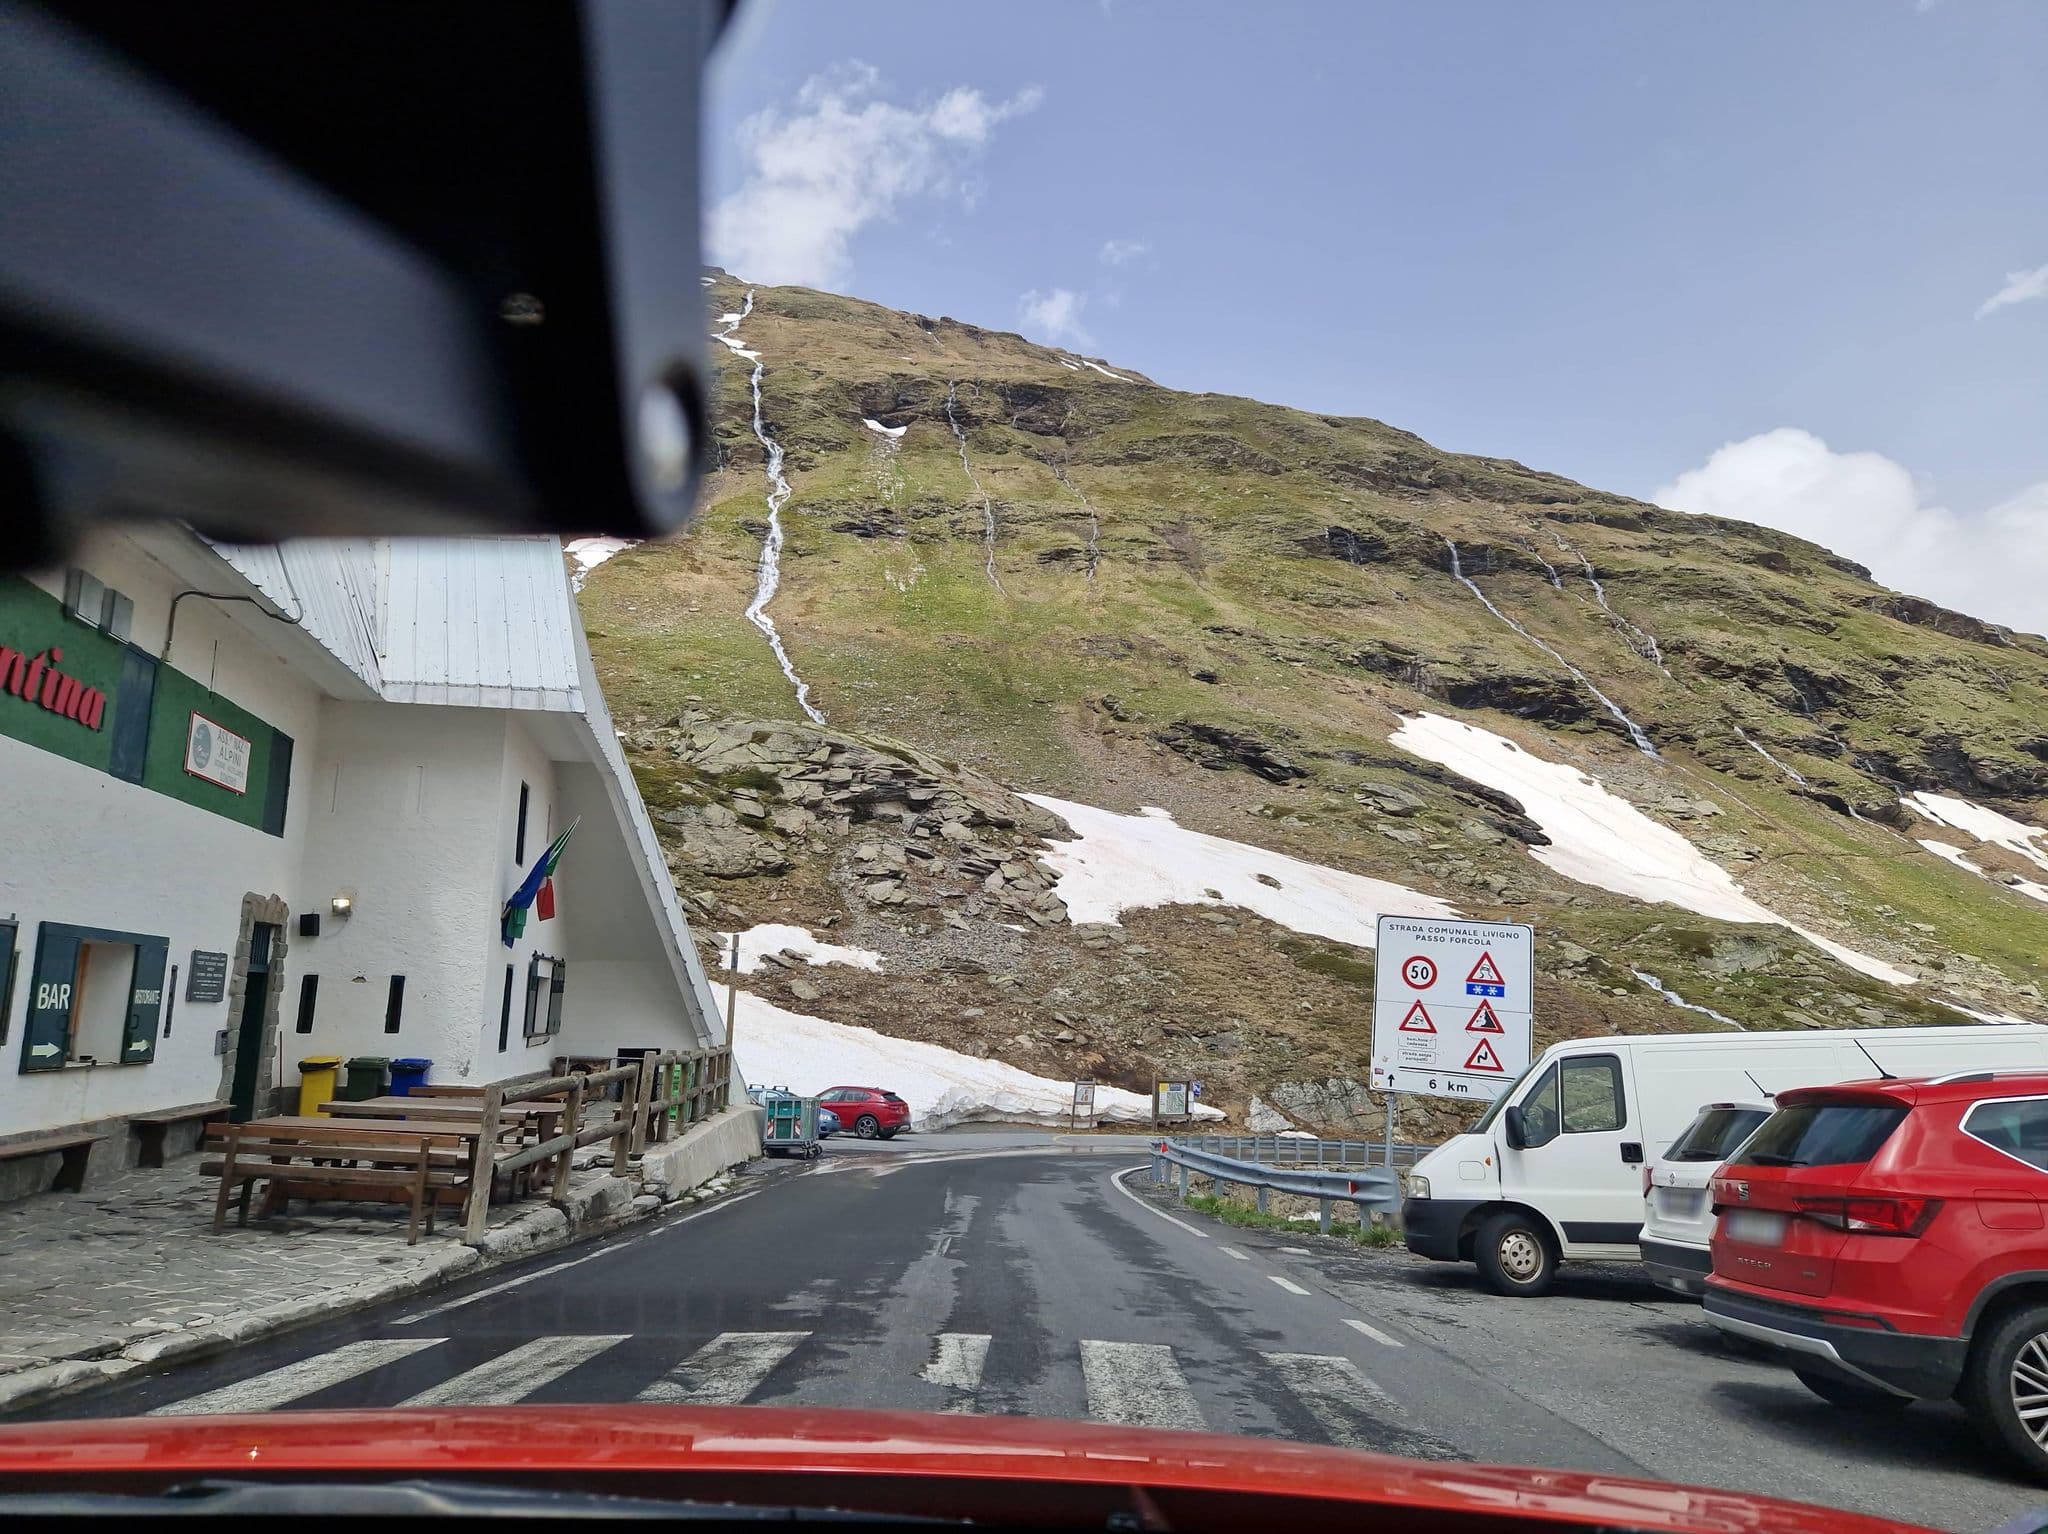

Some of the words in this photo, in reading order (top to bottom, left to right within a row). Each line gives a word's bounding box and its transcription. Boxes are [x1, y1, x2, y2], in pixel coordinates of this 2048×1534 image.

[218, 745, 243, 767] ALPINI
[1389, 924, 1424, 933] STRADA
[1428, 926, 1478, 937] COMUNALE
[1482, 930, 1520, 940] LIVIGNO
[1415, 934, 1446, 943] PASSO
[1450, 936, 1492, 946] FORCOLA
[1410, 965, 1429, 980] 50
[38, 983, 71, 1010] BAR
[1429, 1079, 1437, 1089] 6
[1447, 1080, 1468, 1093] km
